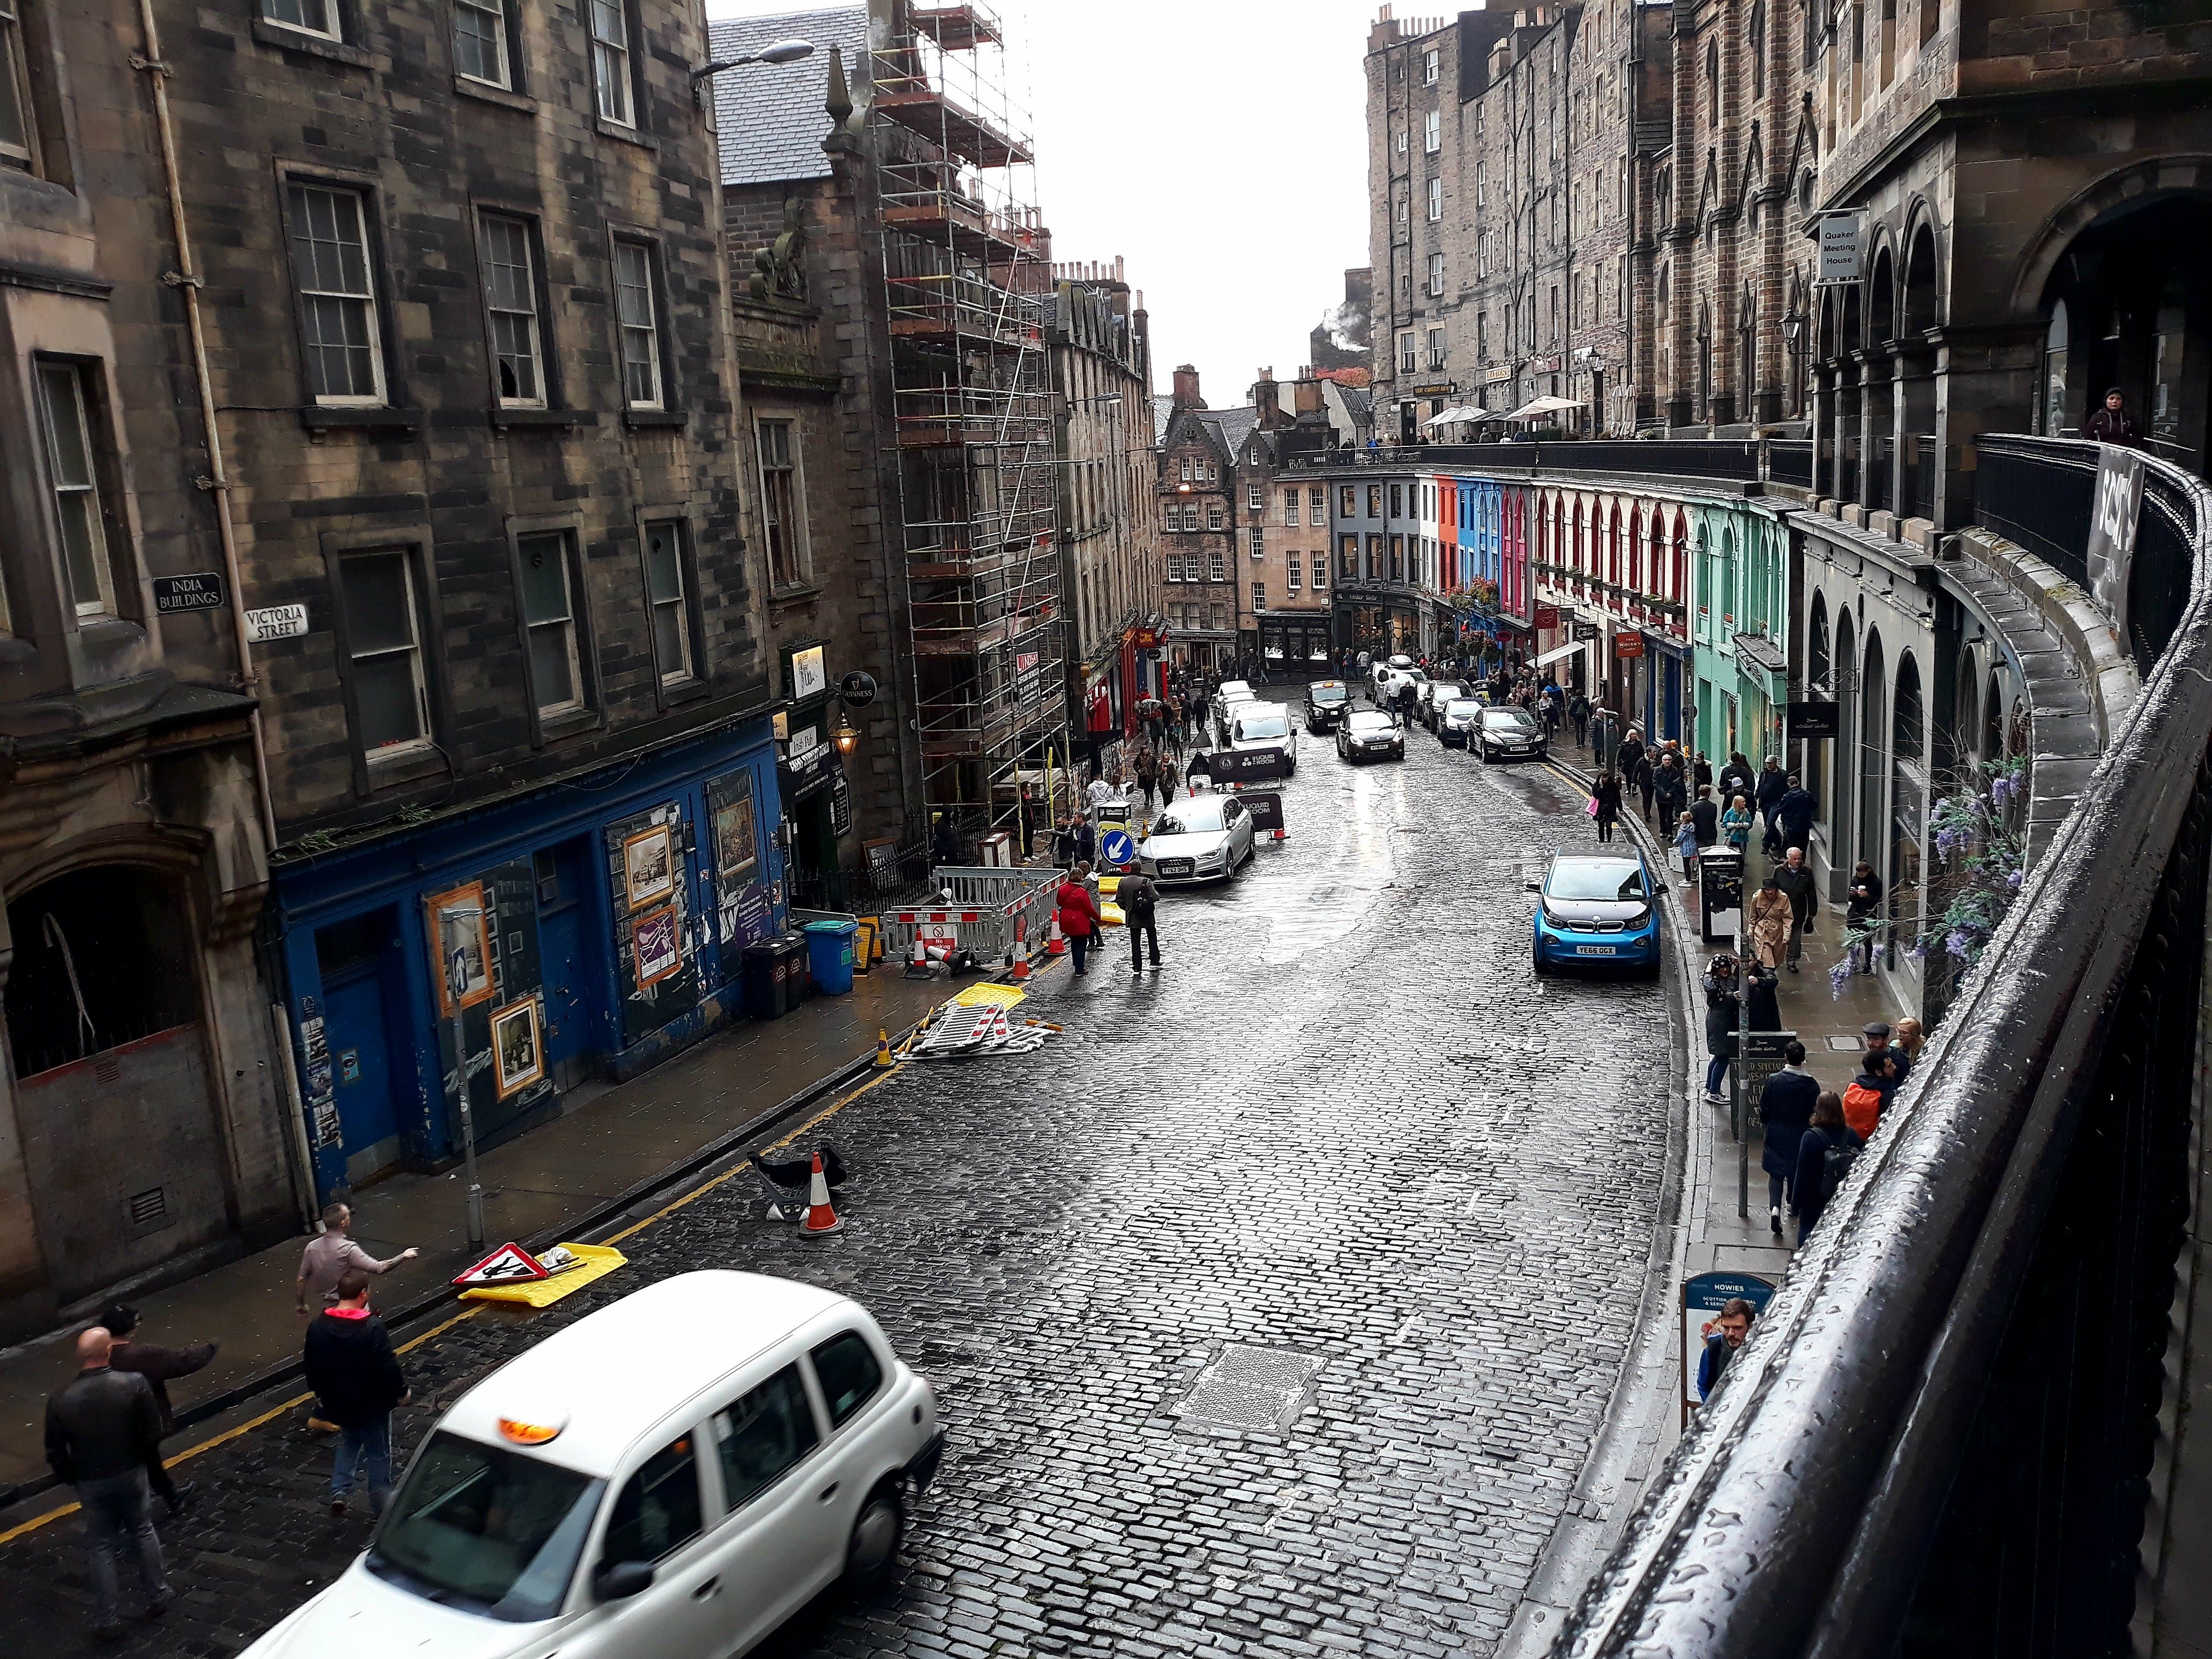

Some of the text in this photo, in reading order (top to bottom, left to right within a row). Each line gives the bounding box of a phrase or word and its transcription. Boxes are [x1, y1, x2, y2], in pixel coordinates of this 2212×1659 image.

[1825, 230, 1855, 241] Quaker
[1824, 243, 1856, 254] Meeting
[1826, 256, 1852, 265] House
[171, 579, 203, 592] INDIA
[159, 592, 219, 609] BUILDINGS
[247, 607, 303, 626] VICTORIA
[257, 622, 299, 639] STREET
[842, 690, 872, 698] GUINNESS
[794, 734, 813, 753] Irish Pub
